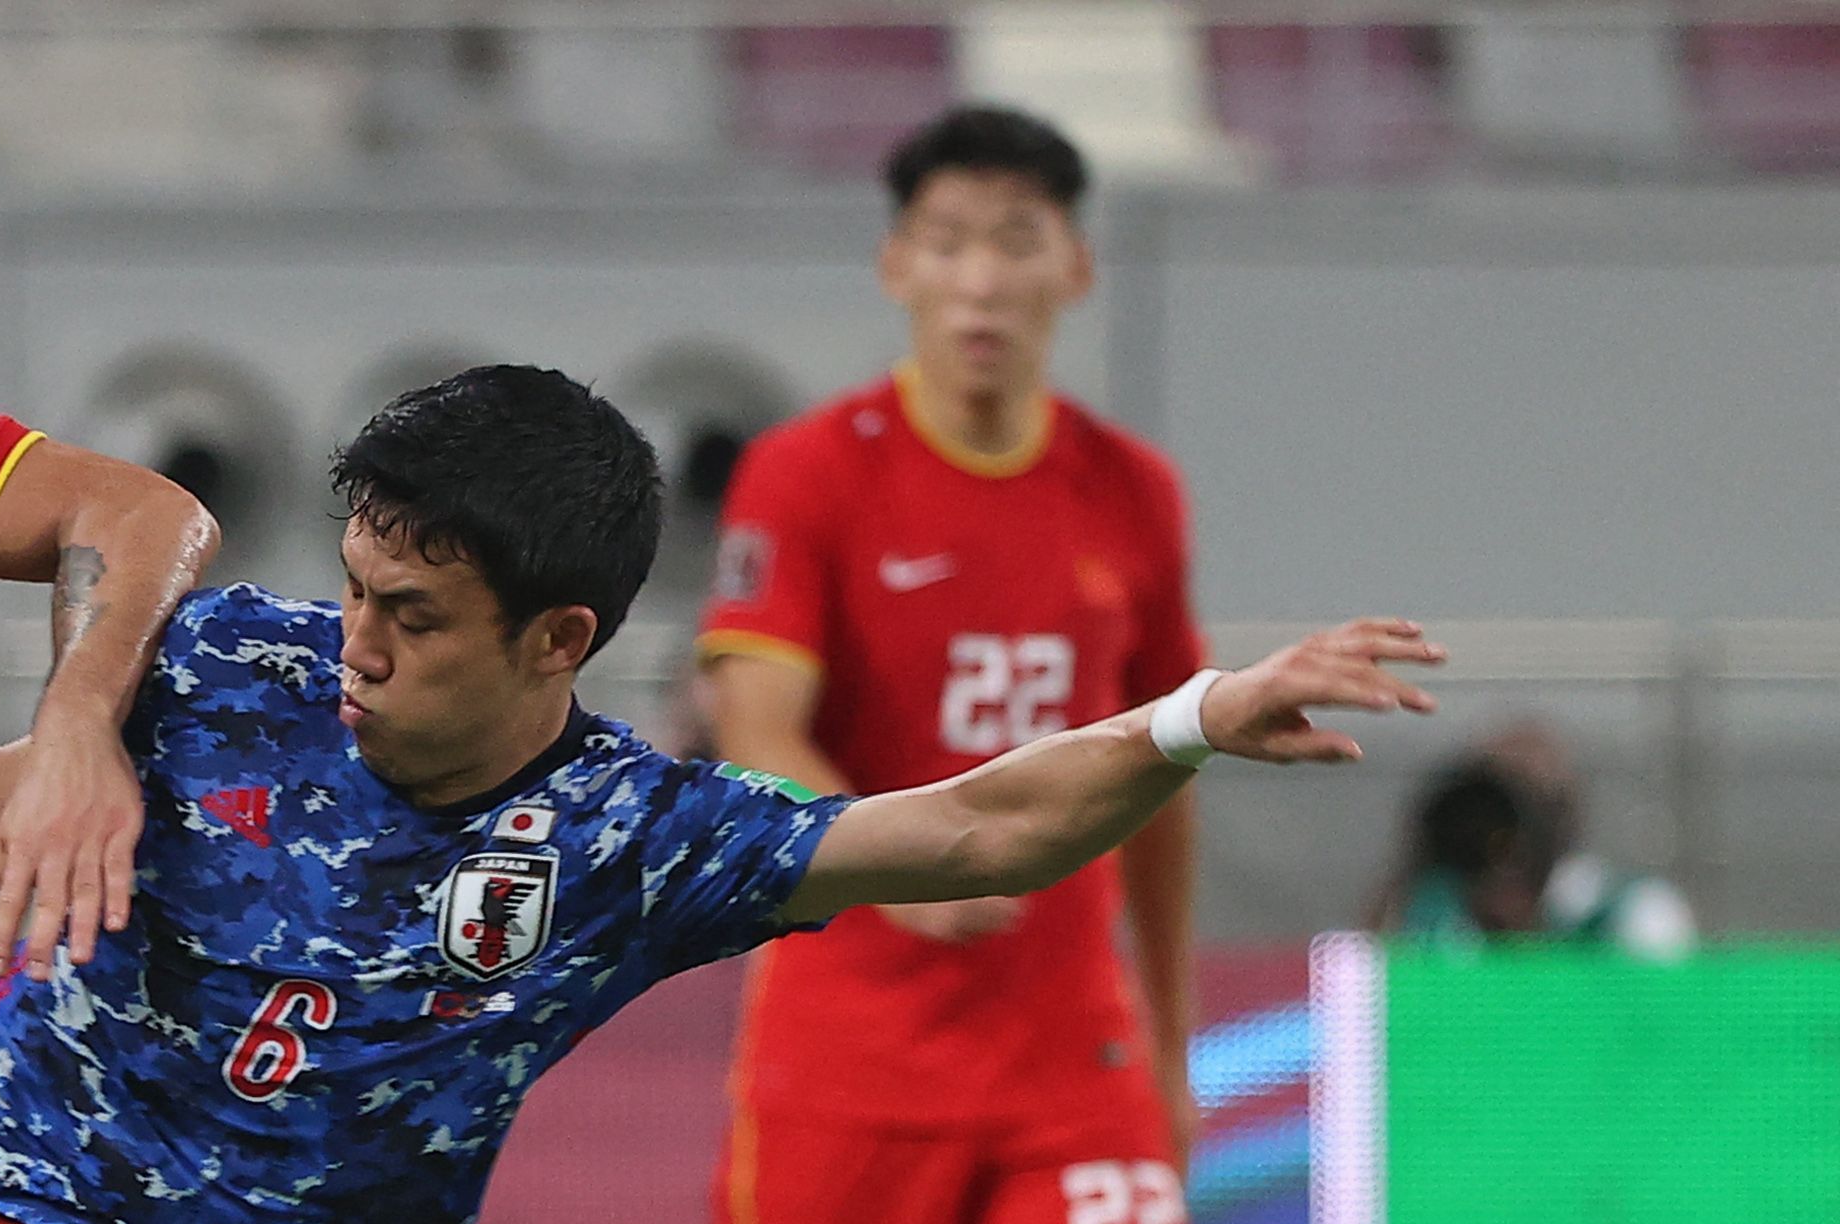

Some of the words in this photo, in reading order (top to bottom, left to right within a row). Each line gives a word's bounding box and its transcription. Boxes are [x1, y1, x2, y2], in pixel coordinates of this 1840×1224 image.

[940, 634, 1075, 756] 22
[474, 857, 530, 872] JAPAN
[221, 978, 337, 1102] 6
